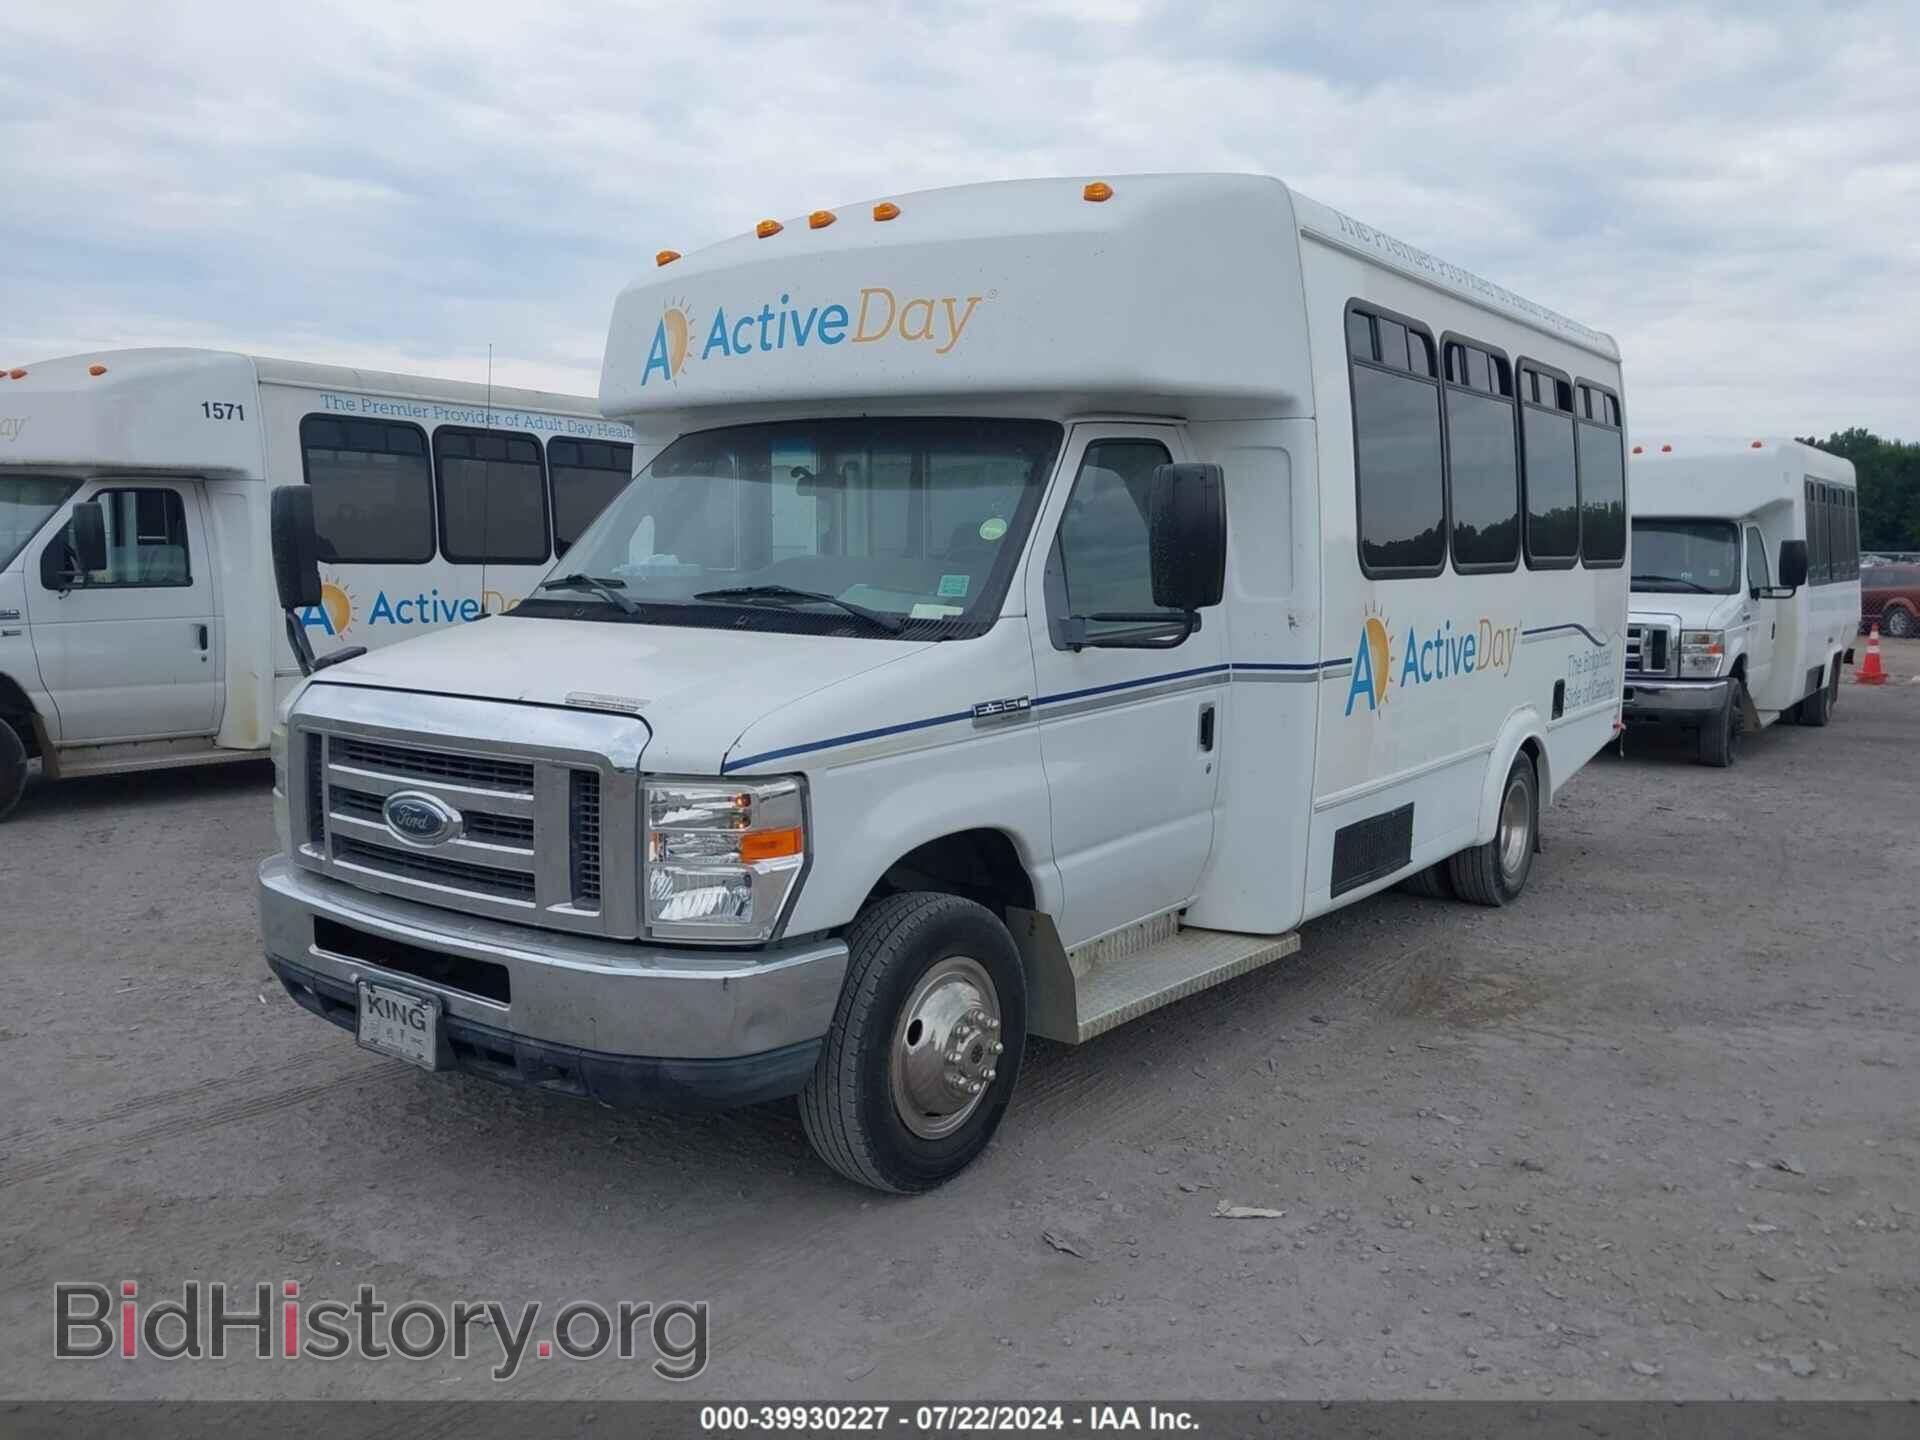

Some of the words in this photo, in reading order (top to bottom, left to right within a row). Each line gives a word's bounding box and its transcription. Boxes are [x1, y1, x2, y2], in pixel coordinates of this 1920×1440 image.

[201, 401, 244, 421] 1571
[319, 393, 357, 411] The
[361, 398, 431, 419] Premier
[433, 405, 500, 426] Provider
[503, 413, 520, 427] of
[524, 415, 563, 431] Adult
[567, 419, 594, 437] Day
[597, 423, 633, 438] Healt
[1400, 618, 1518, 688] ActiveDay
[396, 804, 430, 830] Ford
[367, 994, 427, 1032] KING
